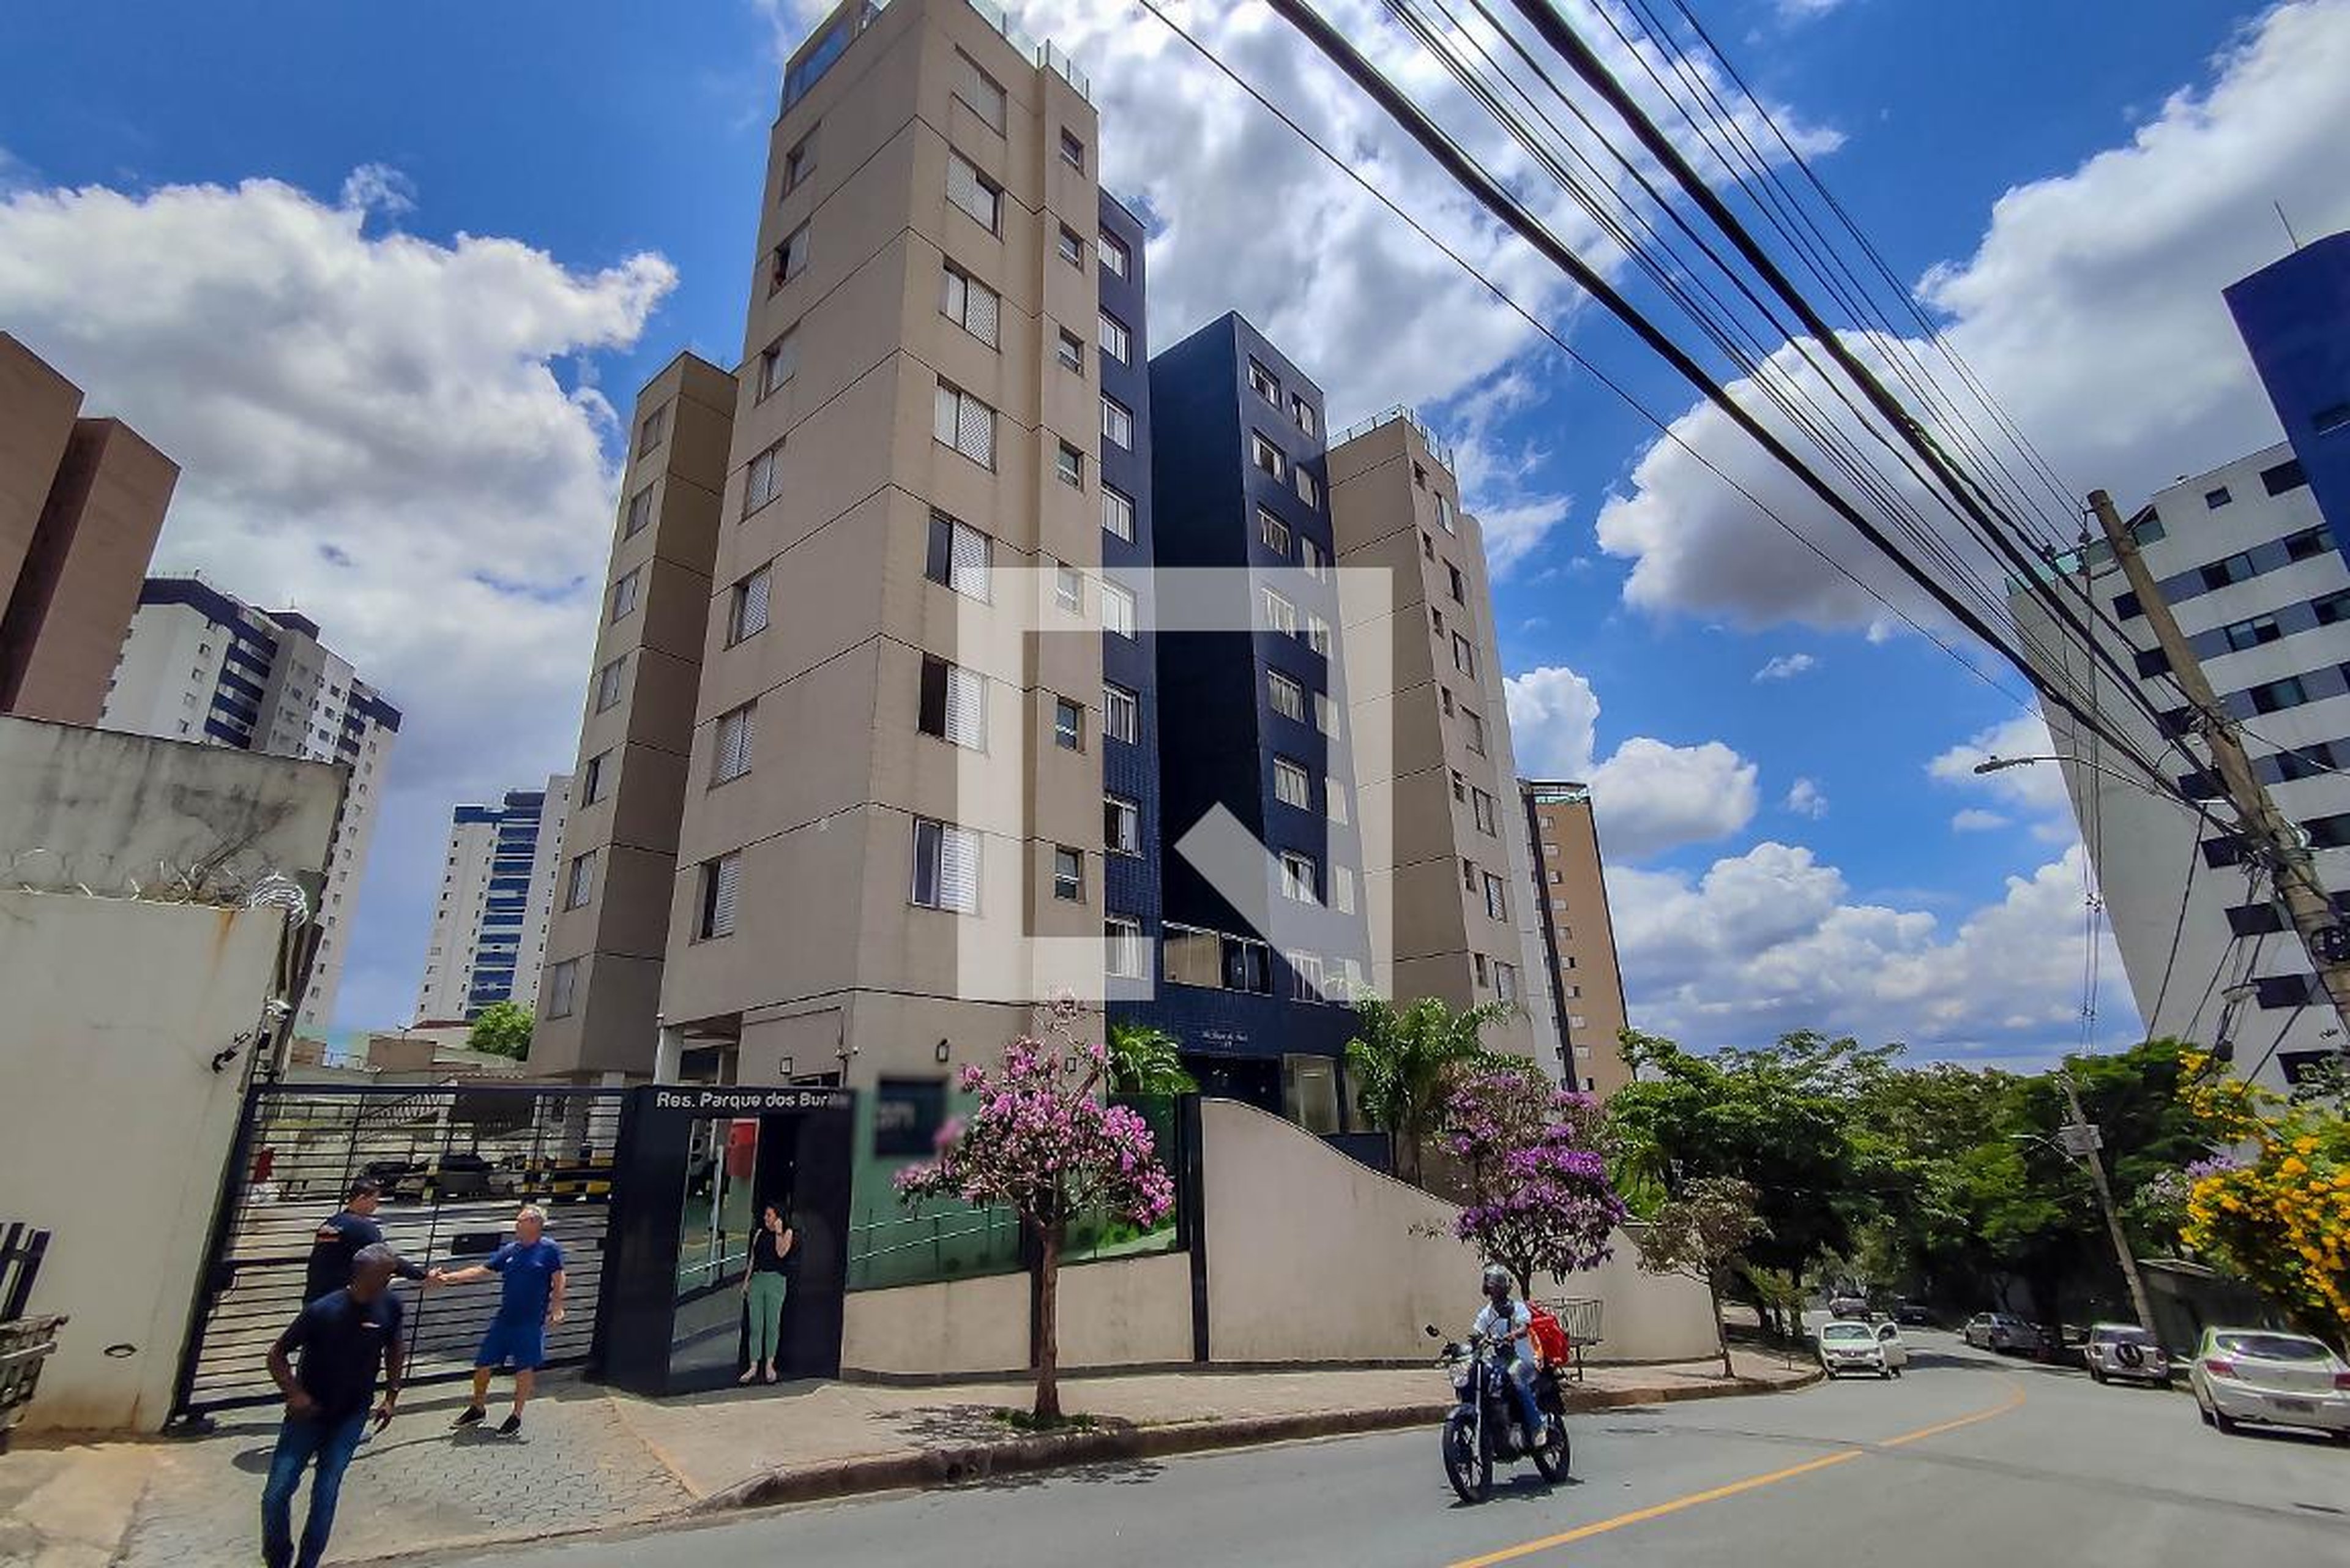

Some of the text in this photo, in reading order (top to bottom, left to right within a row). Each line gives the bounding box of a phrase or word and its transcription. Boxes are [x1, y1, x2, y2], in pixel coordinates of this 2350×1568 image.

[657, 1092, 695, 1107] Res.
[699, 1092, 761, 1110] Parque
[766, 1091, 795, 1107] dos
